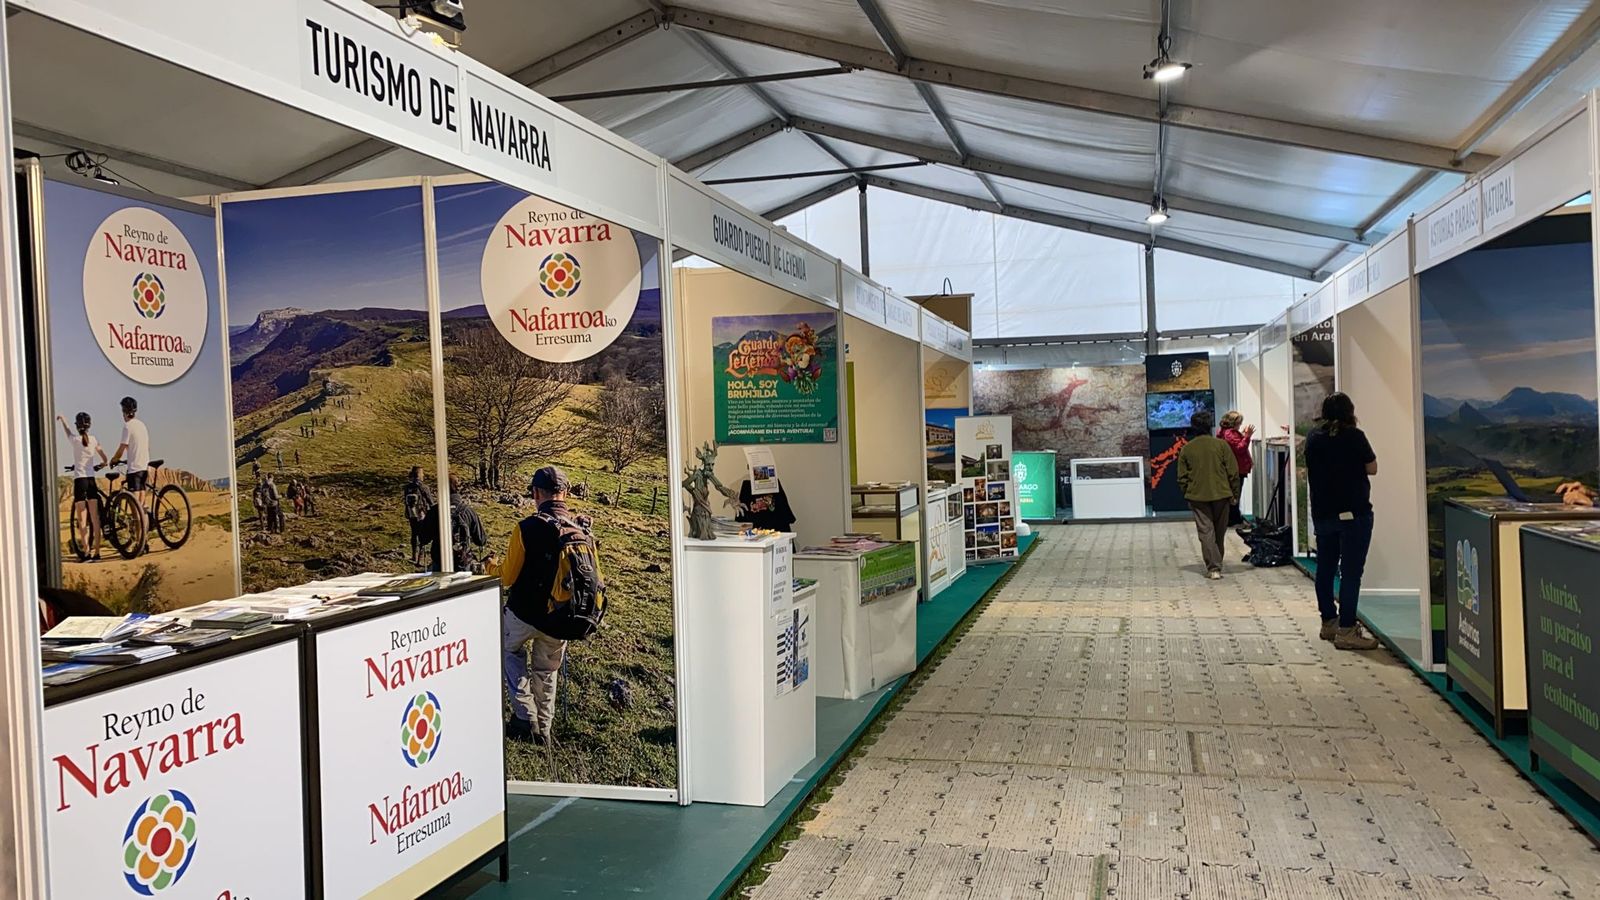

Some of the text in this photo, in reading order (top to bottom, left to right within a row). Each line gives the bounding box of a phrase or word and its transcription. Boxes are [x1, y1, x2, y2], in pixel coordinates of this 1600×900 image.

[306, 18, 552, 171] TURISMO DE NAVARRA
[528, 210, 567, 226] Reyno
[1430, 212, 1454, 248] ASTURIAS
[1483, 176, 1513, 220] NATURAL
[124, 224, 169, 244] Reyno de
[504, 222, 612, 249] Navarra
[713, 214, 807, 281] GUARDO PUEBLO DE LEYENDA
[104, 232, 188, 270] Navarra
[508, 306, 617, 333] Nafarroako
[108, 322, 192, 354] Nafarroako
[535, 333, 592, 346] Erresuma
[130, 352, 174, 367] Erresuma
[727, 380, 778, 390] HOLA, SOY
[727, 390, 778, 399] BRUHJILDA
[390, 617, 447, 652] Reyno de
[364, 638, 469, 698] Navarra
[1542, 649, 1574, 680] para el
[103, 688, 206, 740] Reyno de
[53, 712, 245, 812] Navarra
[368, 771, 473, 844] Nafarroako
[397, 812, 452, 854] Erresuma
